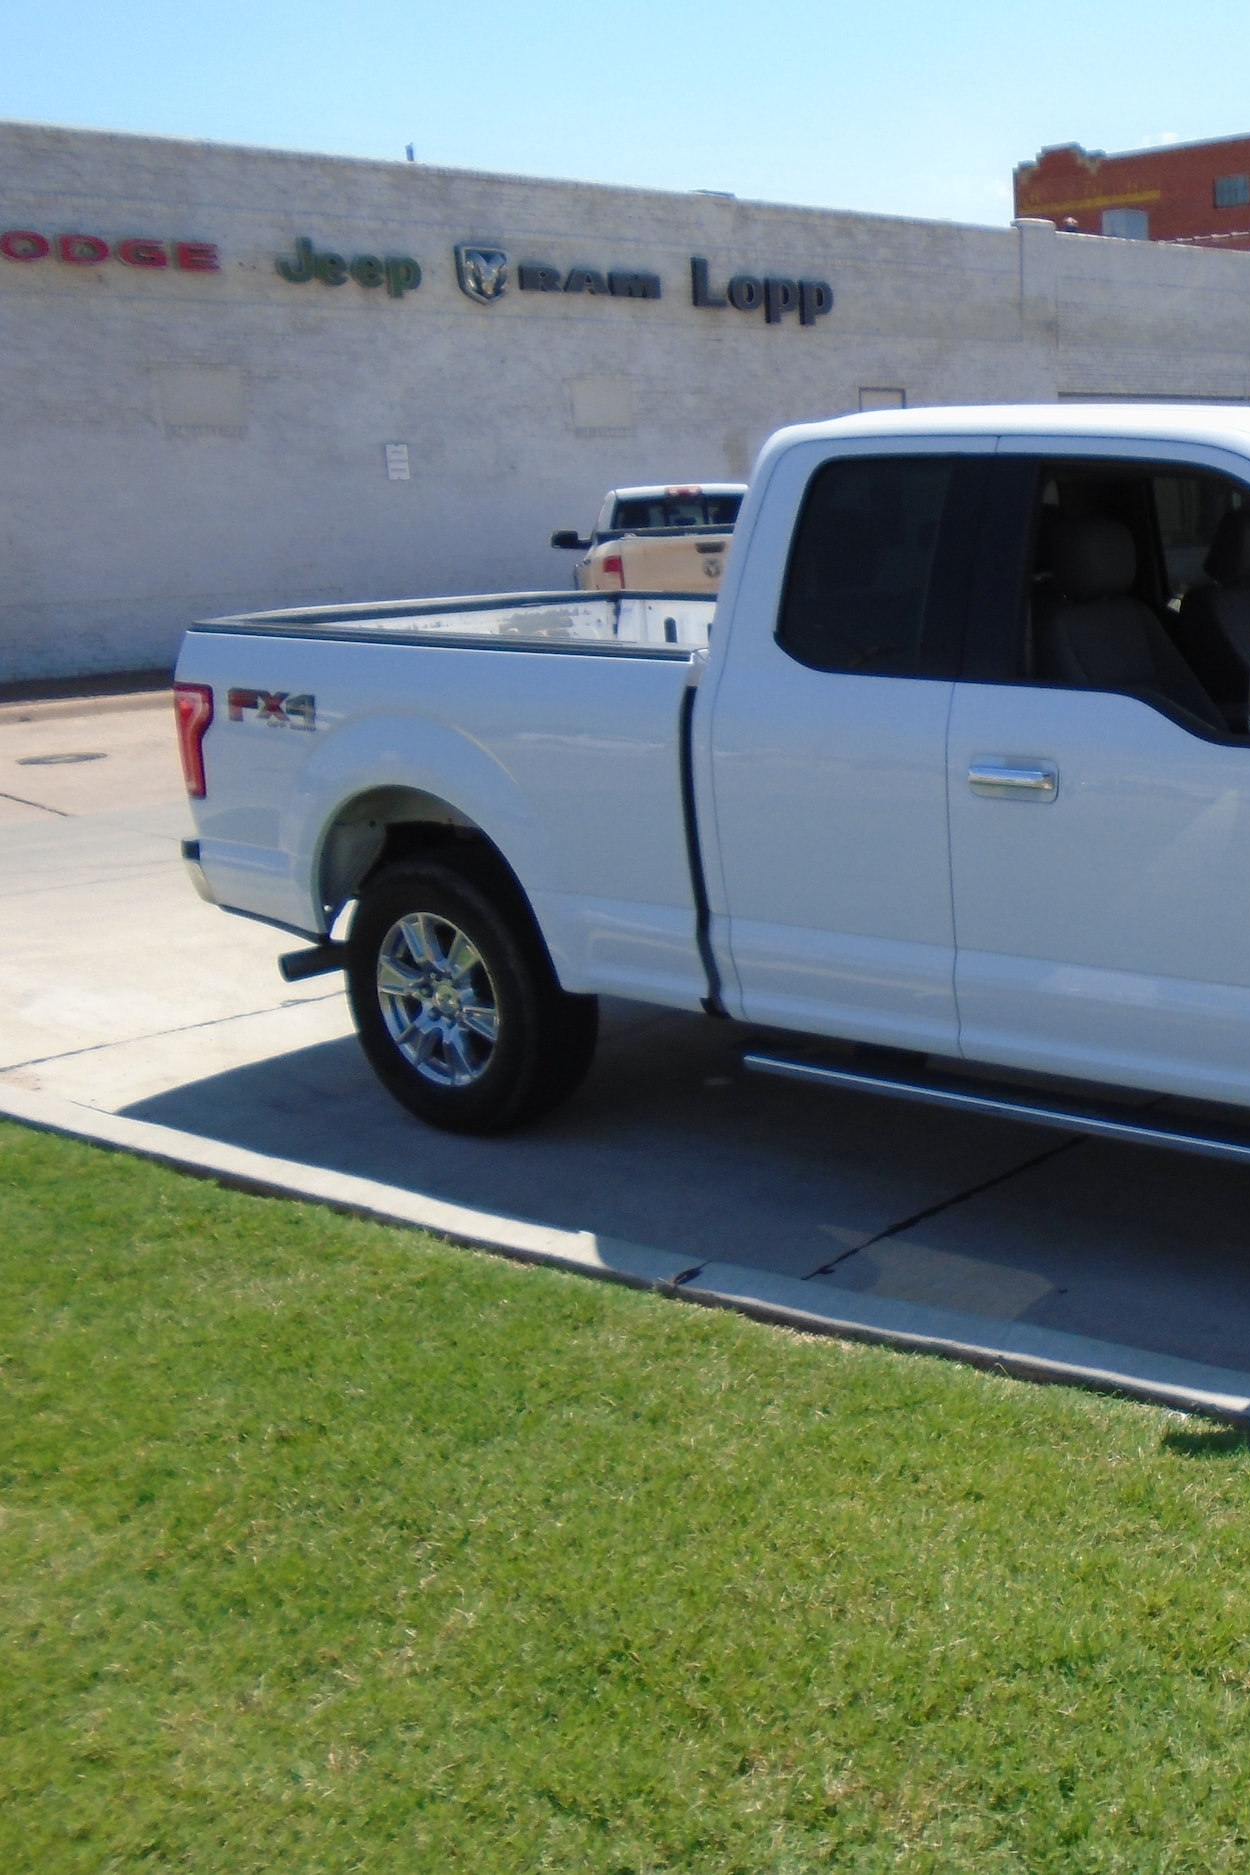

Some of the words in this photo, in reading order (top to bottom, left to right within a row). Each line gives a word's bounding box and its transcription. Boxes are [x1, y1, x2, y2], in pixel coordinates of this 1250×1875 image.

[275, 236, 422, 299] Jeep
[518, 263, 662, 300] RAM
[690, 256, 834, 326] Lopp
[228, 687, 316, 726] FX4
